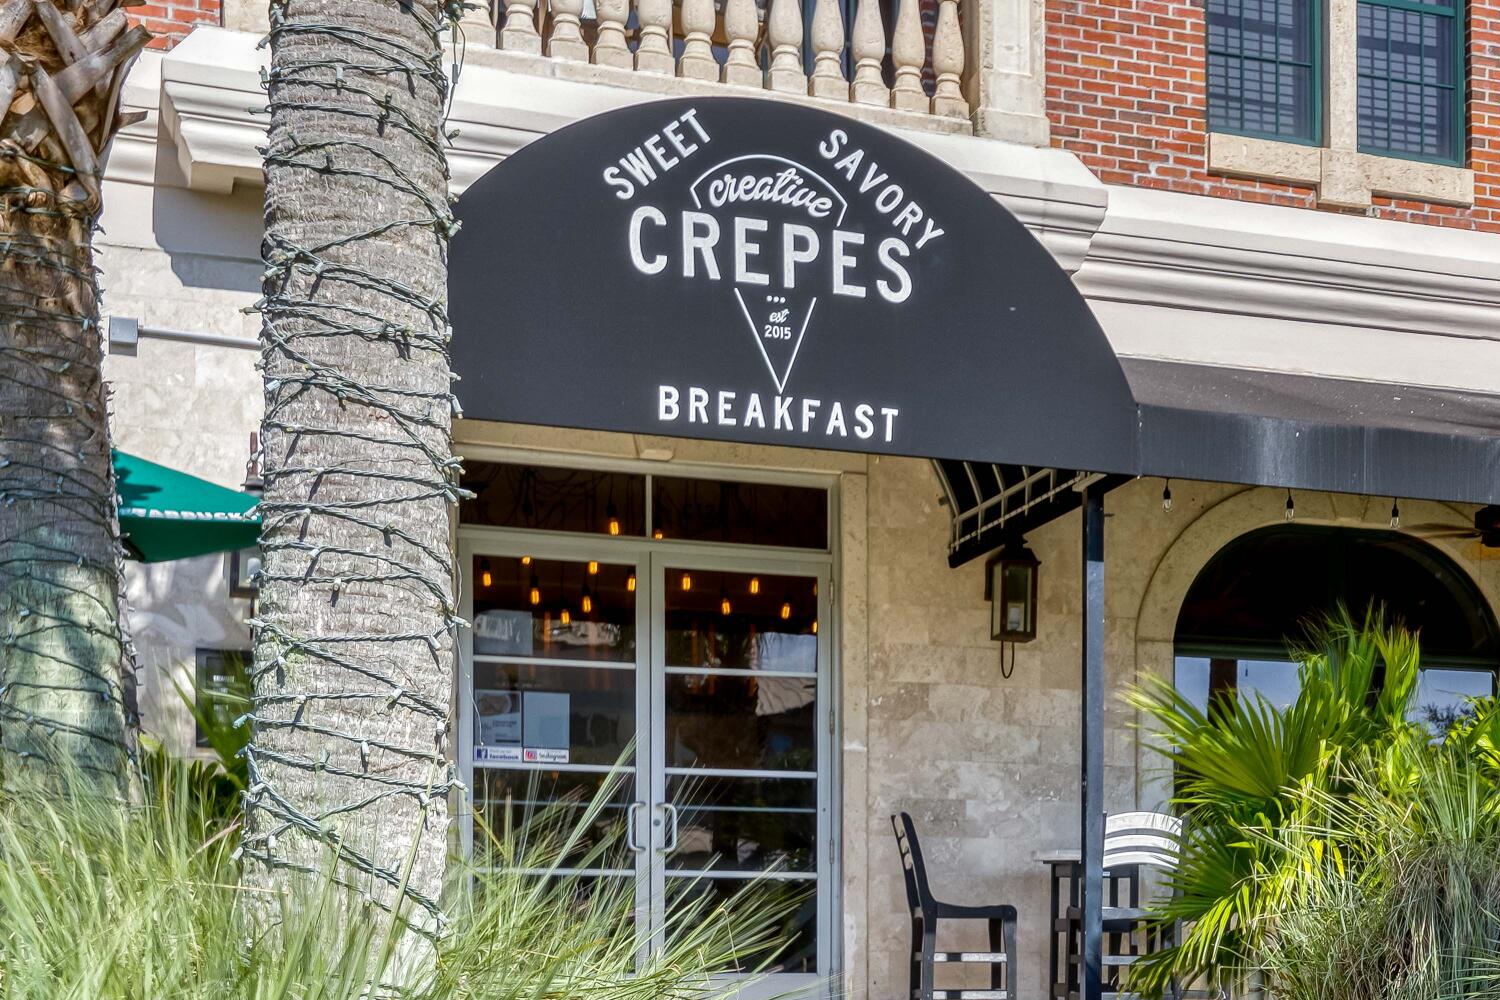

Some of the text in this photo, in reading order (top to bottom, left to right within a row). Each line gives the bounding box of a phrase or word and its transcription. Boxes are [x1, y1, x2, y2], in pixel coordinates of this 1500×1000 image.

[603, 108, 945, 250] SWEET SAVORY
[709, 168, 833, 218] creative
[629, 205, 913, 304] CREPES
[764, 325, 792, 339] 2015
[769, 308, 790, 323] est
[659, 385, 899, 442] BREAKFAST
